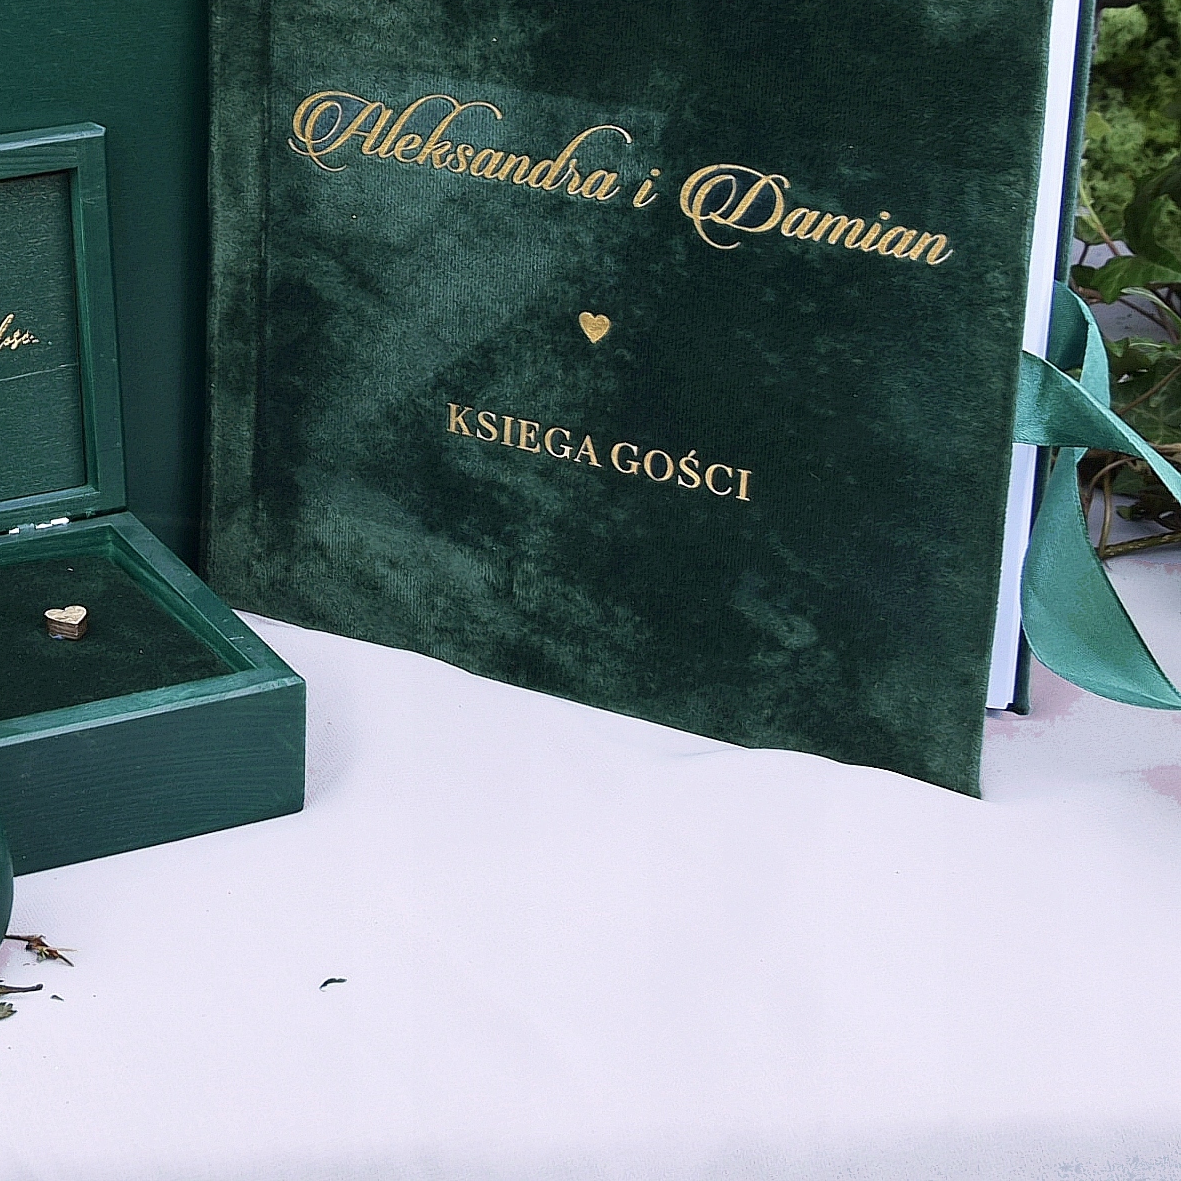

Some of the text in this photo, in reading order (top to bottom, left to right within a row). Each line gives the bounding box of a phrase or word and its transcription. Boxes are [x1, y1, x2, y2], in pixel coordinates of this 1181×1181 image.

[288, 89, 953, 266] Aleksandra i Damian
[446, 402, 753, 502] KSIEGA GOŚCI
